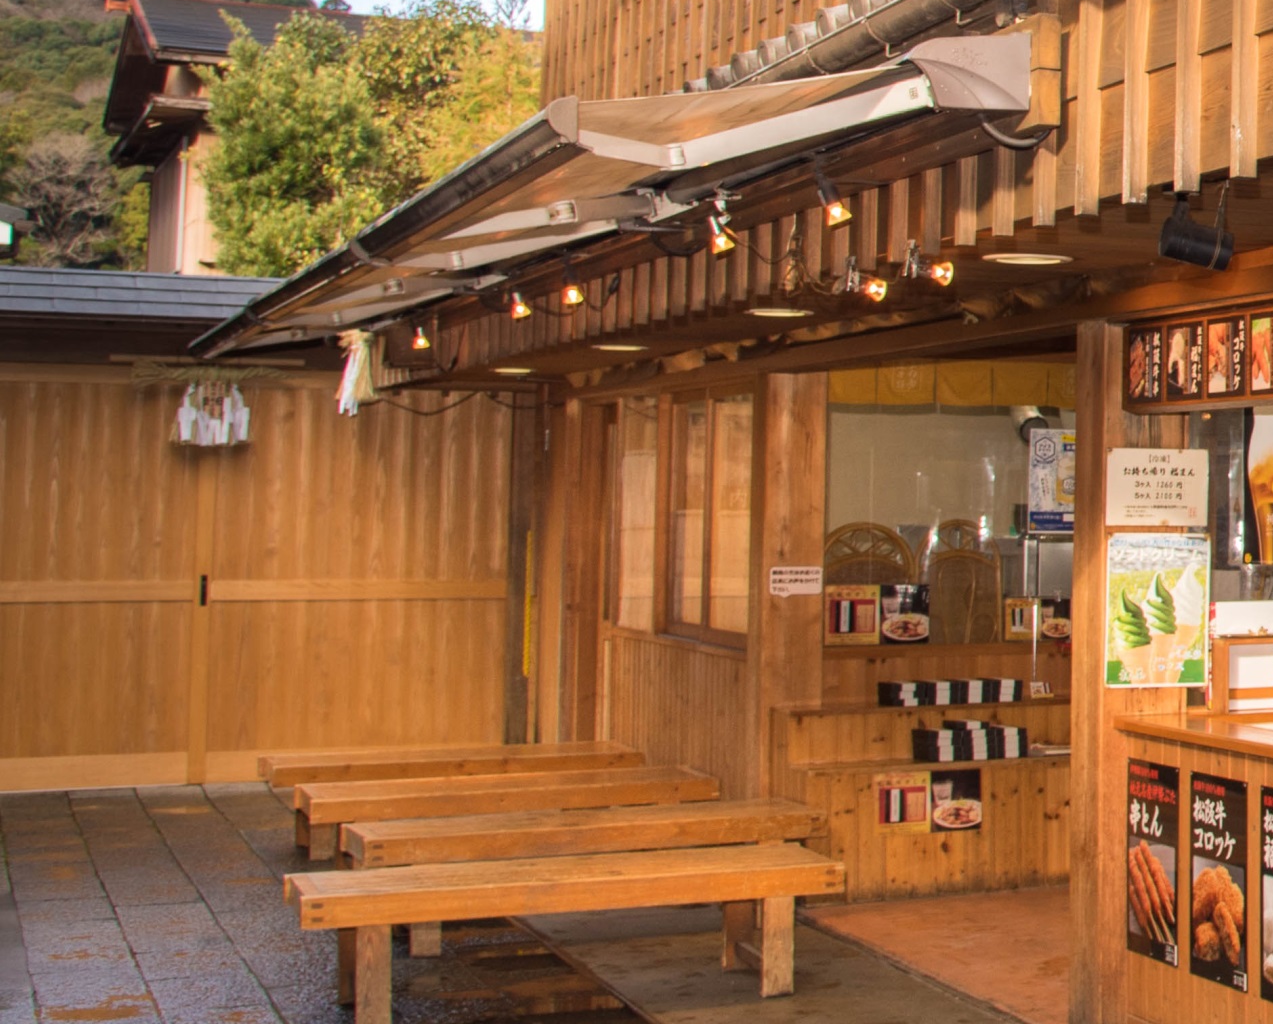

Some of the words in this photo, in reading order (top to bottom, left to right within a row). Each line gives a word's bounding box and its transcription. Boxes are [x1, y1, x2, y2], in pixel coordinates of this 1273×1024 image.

[1233, 337, 1241, 390] コロッケ
[1123, 467, 1166, 476] お持ち帰り
[1170, 467, 1196, 477] 福まん
[1113, 547, 1203, 563] ソフトクリーム
[1129, 798, 1163, 838] 串とん
[1193, 795, 1226, 829] 松阪牛
[1194, 828, 1236, 860] コロッケ
